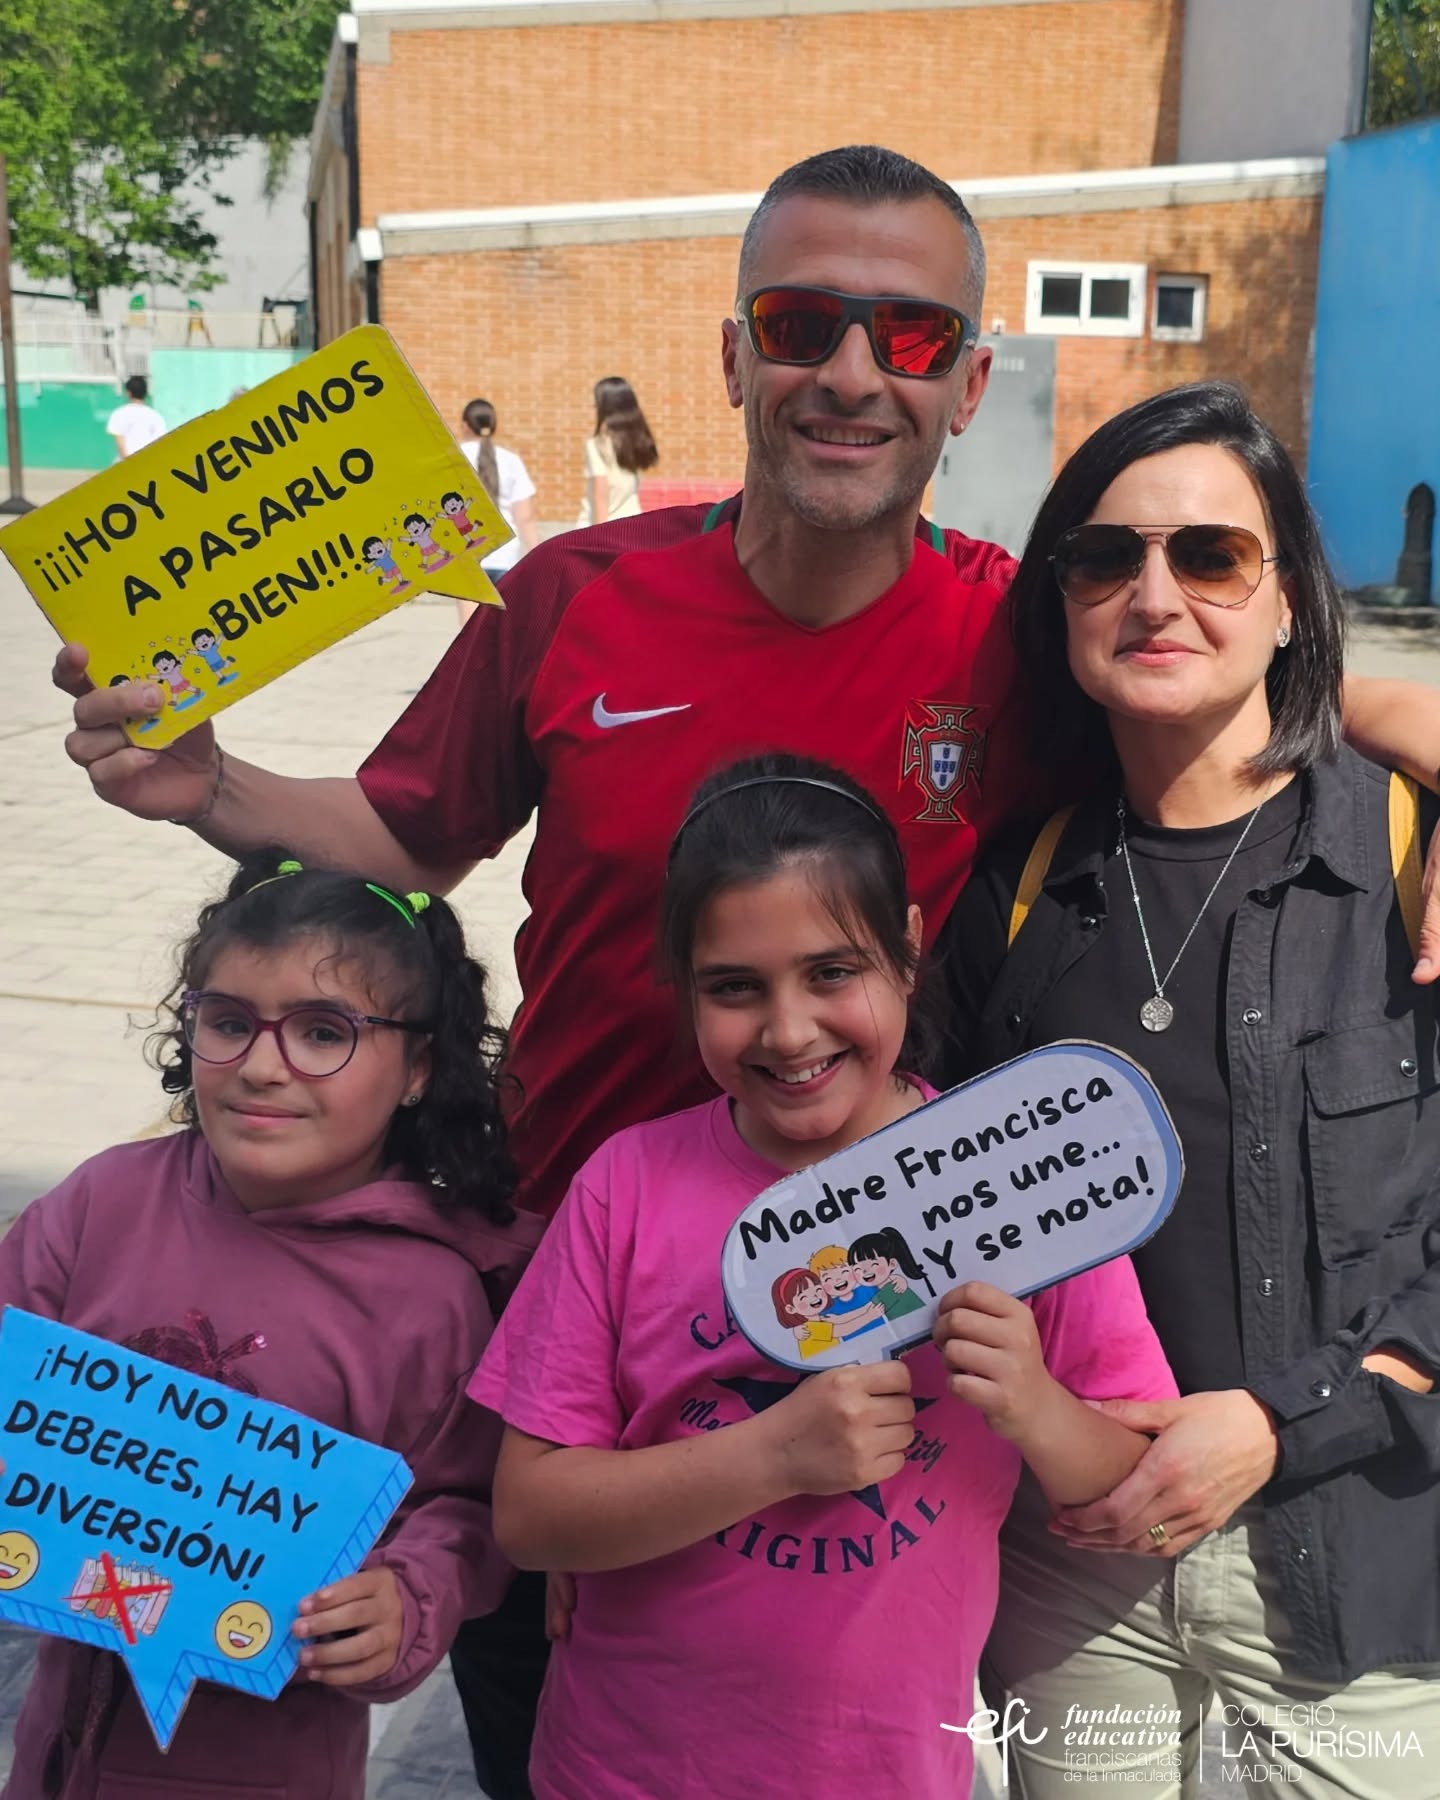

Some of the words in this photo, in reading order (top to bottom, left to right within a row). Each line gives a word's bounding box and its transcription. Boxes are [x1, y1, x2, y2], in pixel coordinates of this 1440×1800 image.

[34, 480, 165, 593] ¡¡¡HOY
[171, 360, 384, 494] VENIMOS
[124, 575, 162, 617] A
[160, 446, 374, 590] PASARLO
[208, 533, 362, 641] BIEN!!!
[739, 1175, 887, 1261] Madre
[894, 1077, 1113, 1189] Francisca
[922, 1180, 998, 1232] nos
[1009, 1141, 1121, 1191] une...
[975, 1224, 1023, 1261] se
[1036, 1155, 1154, 1235] nota!
[4, 1399, 202, 1499] DEBERES,
[217, 1475, 318, 1533] HAY
[34, 1345, 153, 1403] ¡HOY
[158, 1383, 228, 1430] NO
[237, 1412, 337, 1469] HAY
[6, 1473, 265, 1591] DIVERSIÓN!
[713, 1496, 947, 1575] IGINAL
